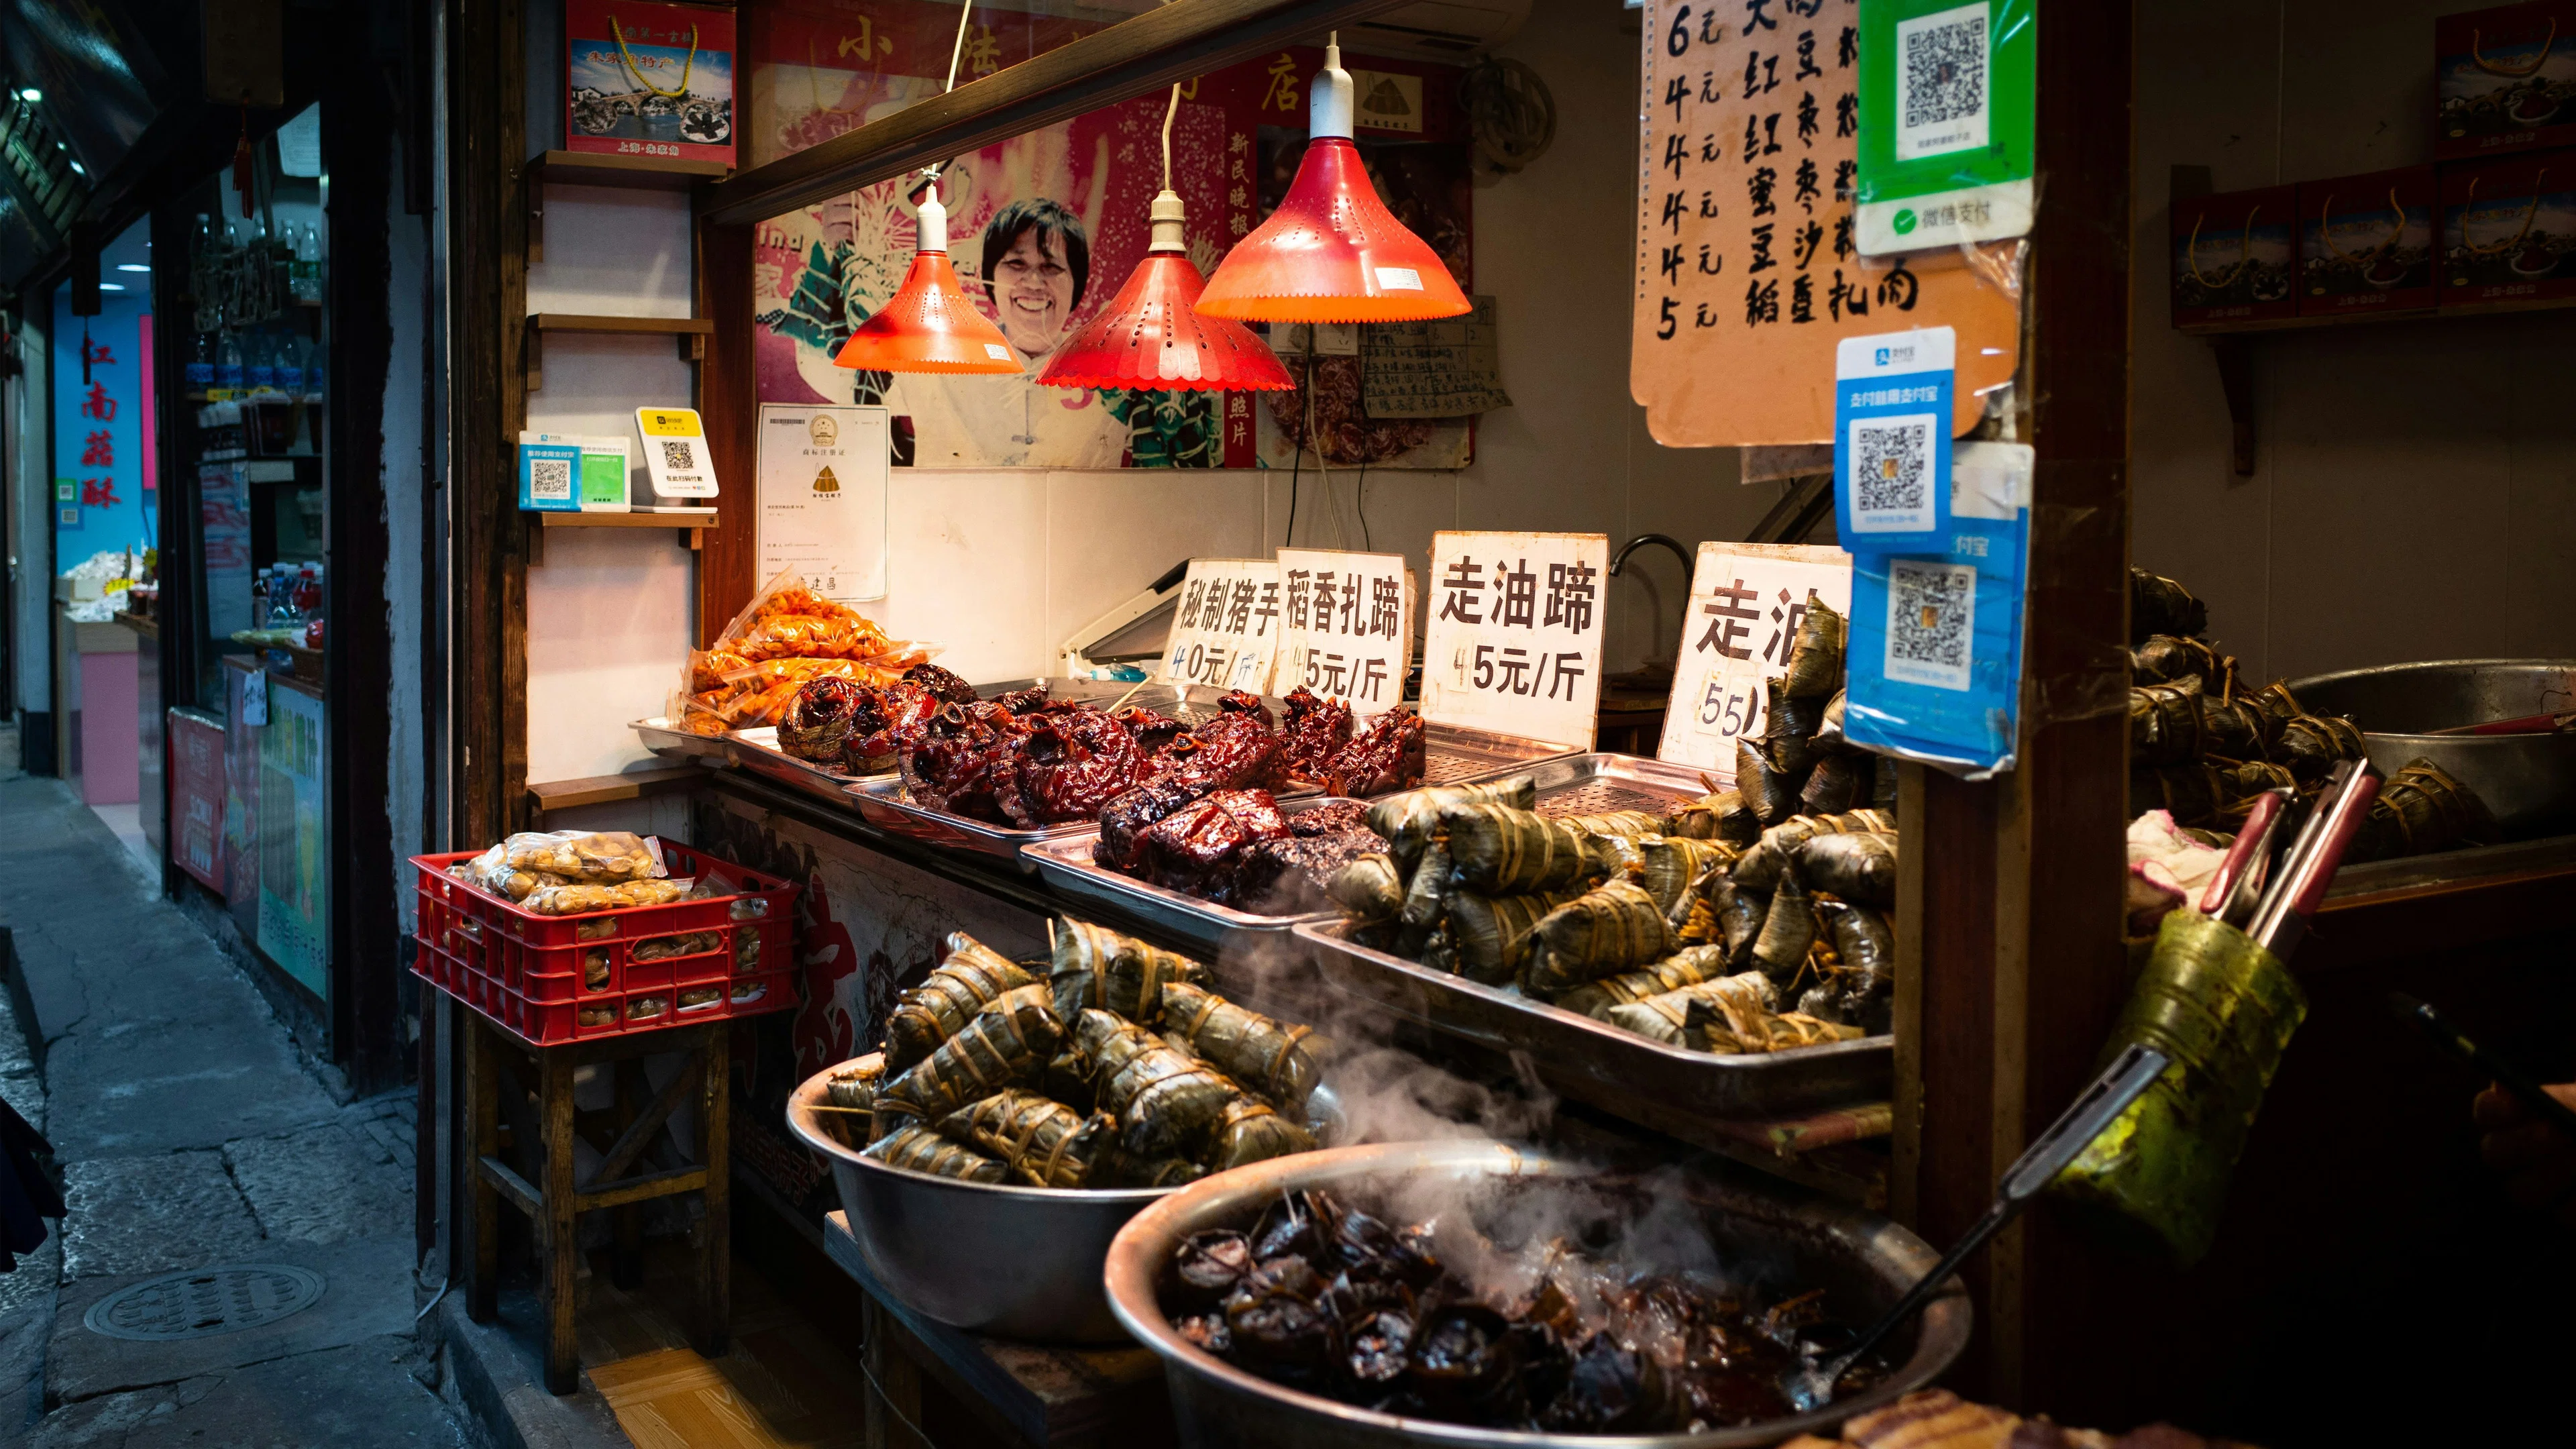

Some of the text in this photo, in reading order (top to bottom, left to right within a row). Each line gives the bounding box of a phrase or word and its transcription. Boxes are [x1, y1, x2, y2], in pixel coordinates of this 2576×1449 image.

[1668, 5, 1722, 58] 6元
[1664, 72, 1720, 123] 4元
[617, 141, 680, 156] 上海·朱家角
[1664, 133, 1721, 180] 4元
[1662, 190, 1719, 236] 4元
[1923, 200, 1992, 228] 微信支付
[1228, 131, 1250, 447] 新民晚报 照片
[1662, 244, 1722, 287] 4元
[1657, 297, 1717, 341] 5元
[1951, 534, 1990, 557] 付宝
[1180, 578, 1279, 637] 秘制猪手
[1287, 569, 1399, 641] 稻香扎蹄
[1440, 555, 1597, 635] 走油蹄
[1453, 645, 1585, 702] 45元/斤
